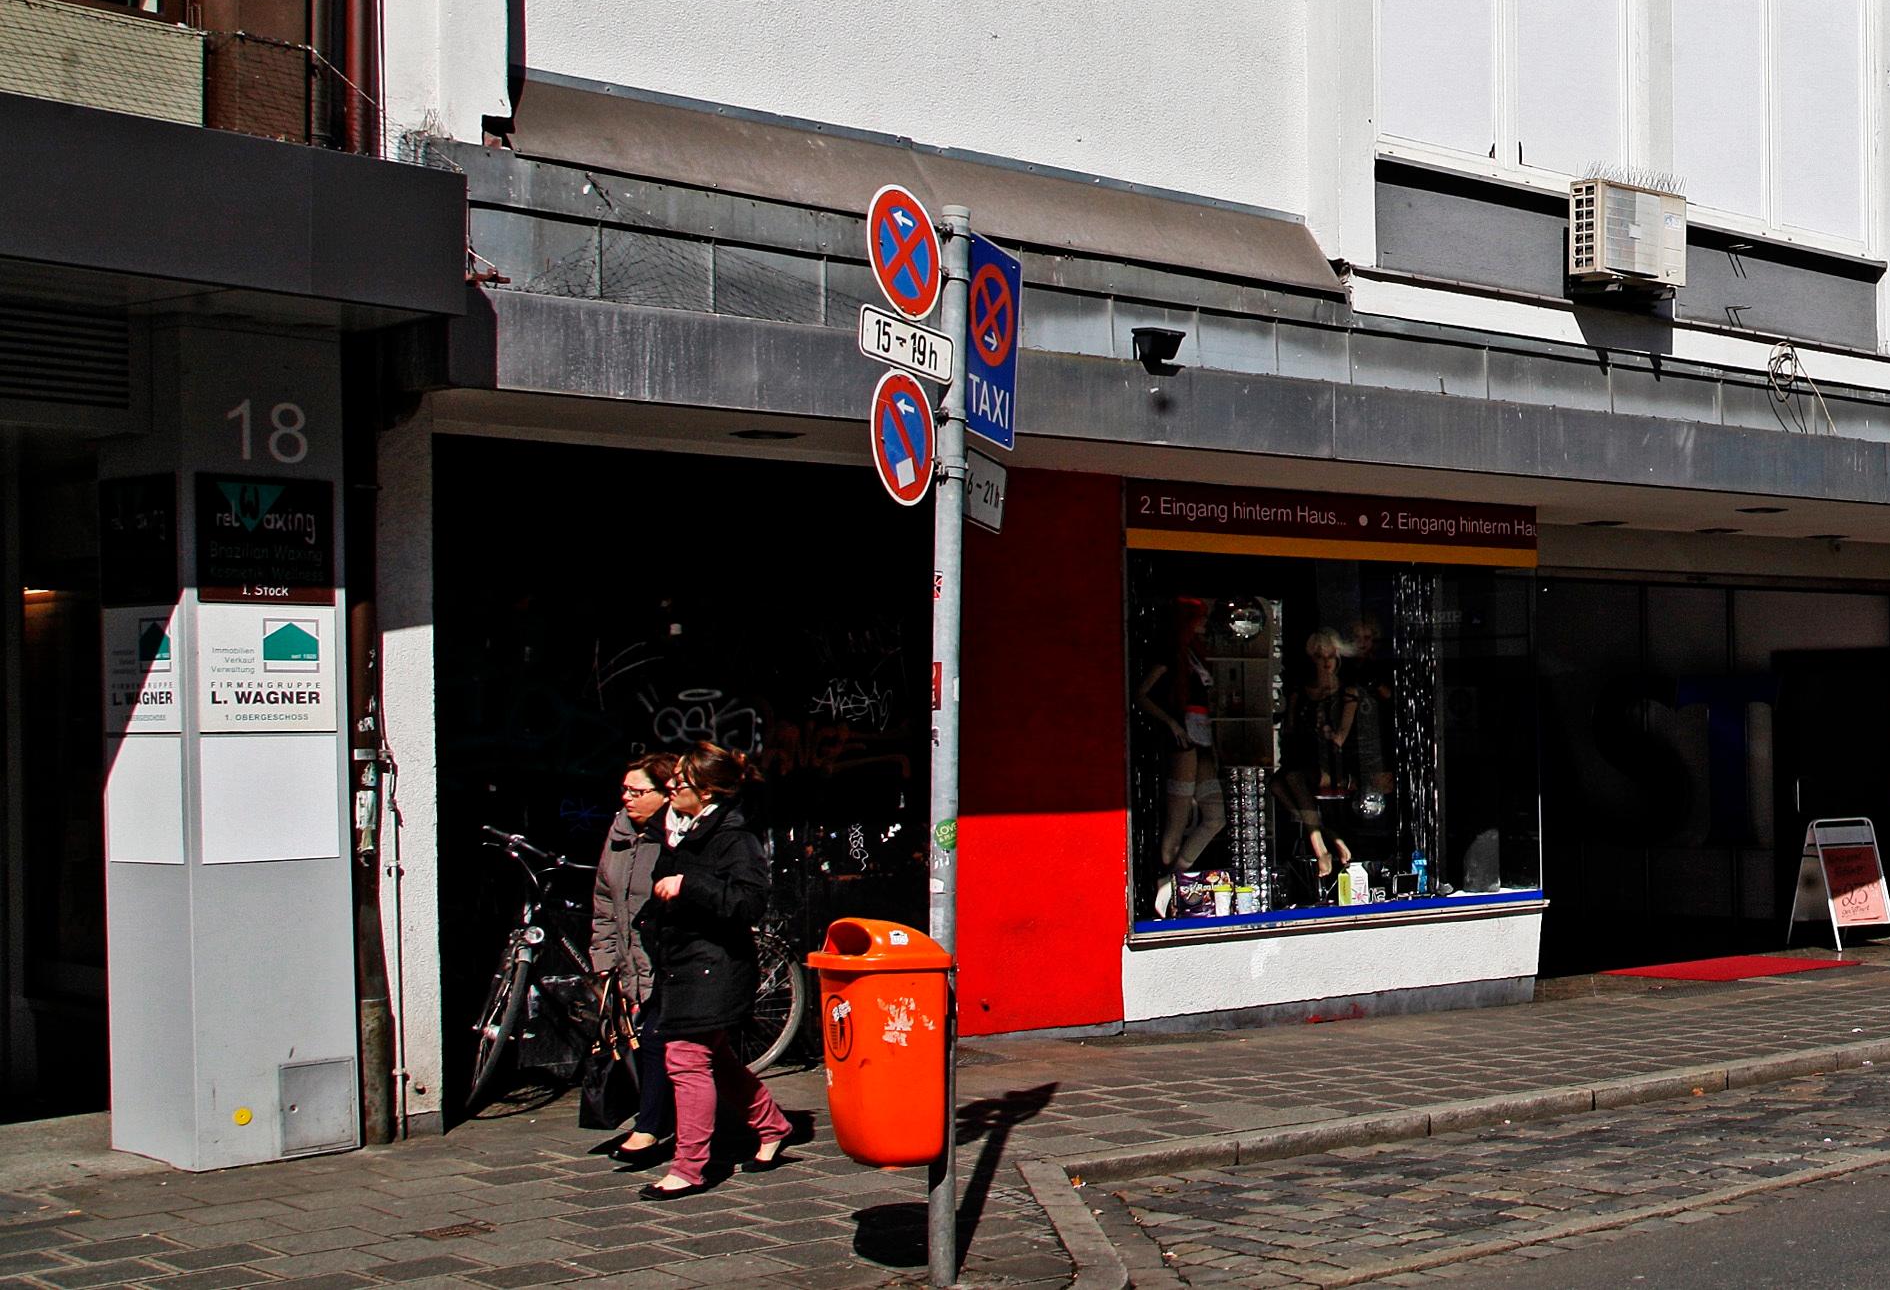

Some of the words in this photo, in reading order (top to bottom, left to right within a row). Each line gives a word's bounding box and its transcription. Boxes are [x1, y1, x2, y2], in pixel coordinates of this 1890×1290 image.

[875, 318, 892, 354] 15
[910, 332, 927, 366] 19
[968, 372, 1010, 430] TAXI
[226, 398, 309, 464] 18
[1141, 496, 1155, 514] 2.
[1160, 497, 1228, 524] Eingang
[1233, 502, 1292, 523] hinterm
[1381, 512, 1394, 529] 2.
[1398, 513, 1456, 536] Eingang
[1460, 516, 1511, 536] hinterm
[254, 583, 289, 597] Stock
[211, 647, 255, 655] Immobilien
[224, 656, 255, 664] Verkauf
[211, 665, 256, 675] Verwaltung
[210, 681, 321, 689] FIRMENGRUPPE
[124, 691, 173, 706] WAGNER
[211, 690, 228, 705] L.
[234, 690, 321, 705] WAGNER
[235, 713, 309, 721] OBERGESCHOSS
